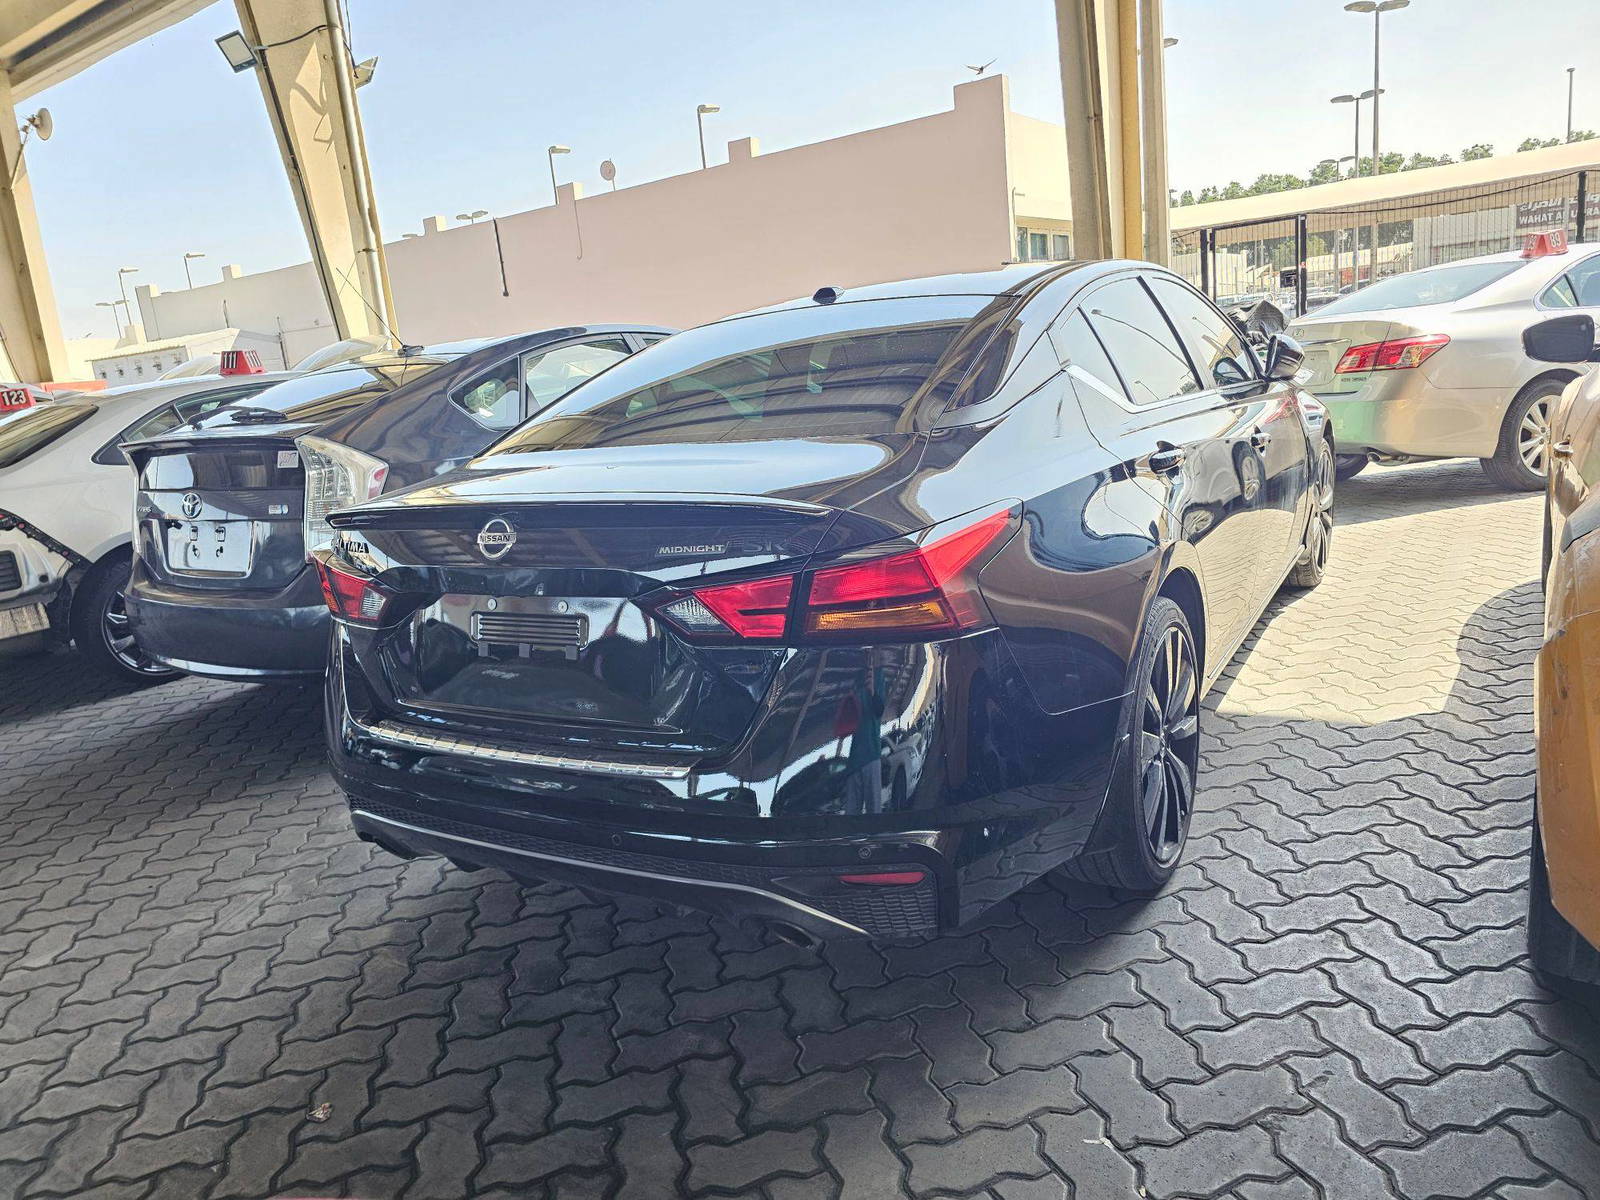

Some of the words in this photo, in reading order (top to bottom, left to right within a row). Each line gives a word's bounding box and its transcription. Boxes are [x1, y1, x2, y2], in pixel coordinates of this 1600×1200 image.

[1519, 213, 1553, 225] WAHAT
[224, 351, 236, 369] 111
[2, 390, 26, 406] 123
[480, 534, 511, 543] NISSAN
[658, 544, 725, 554] MIDNIGHT
